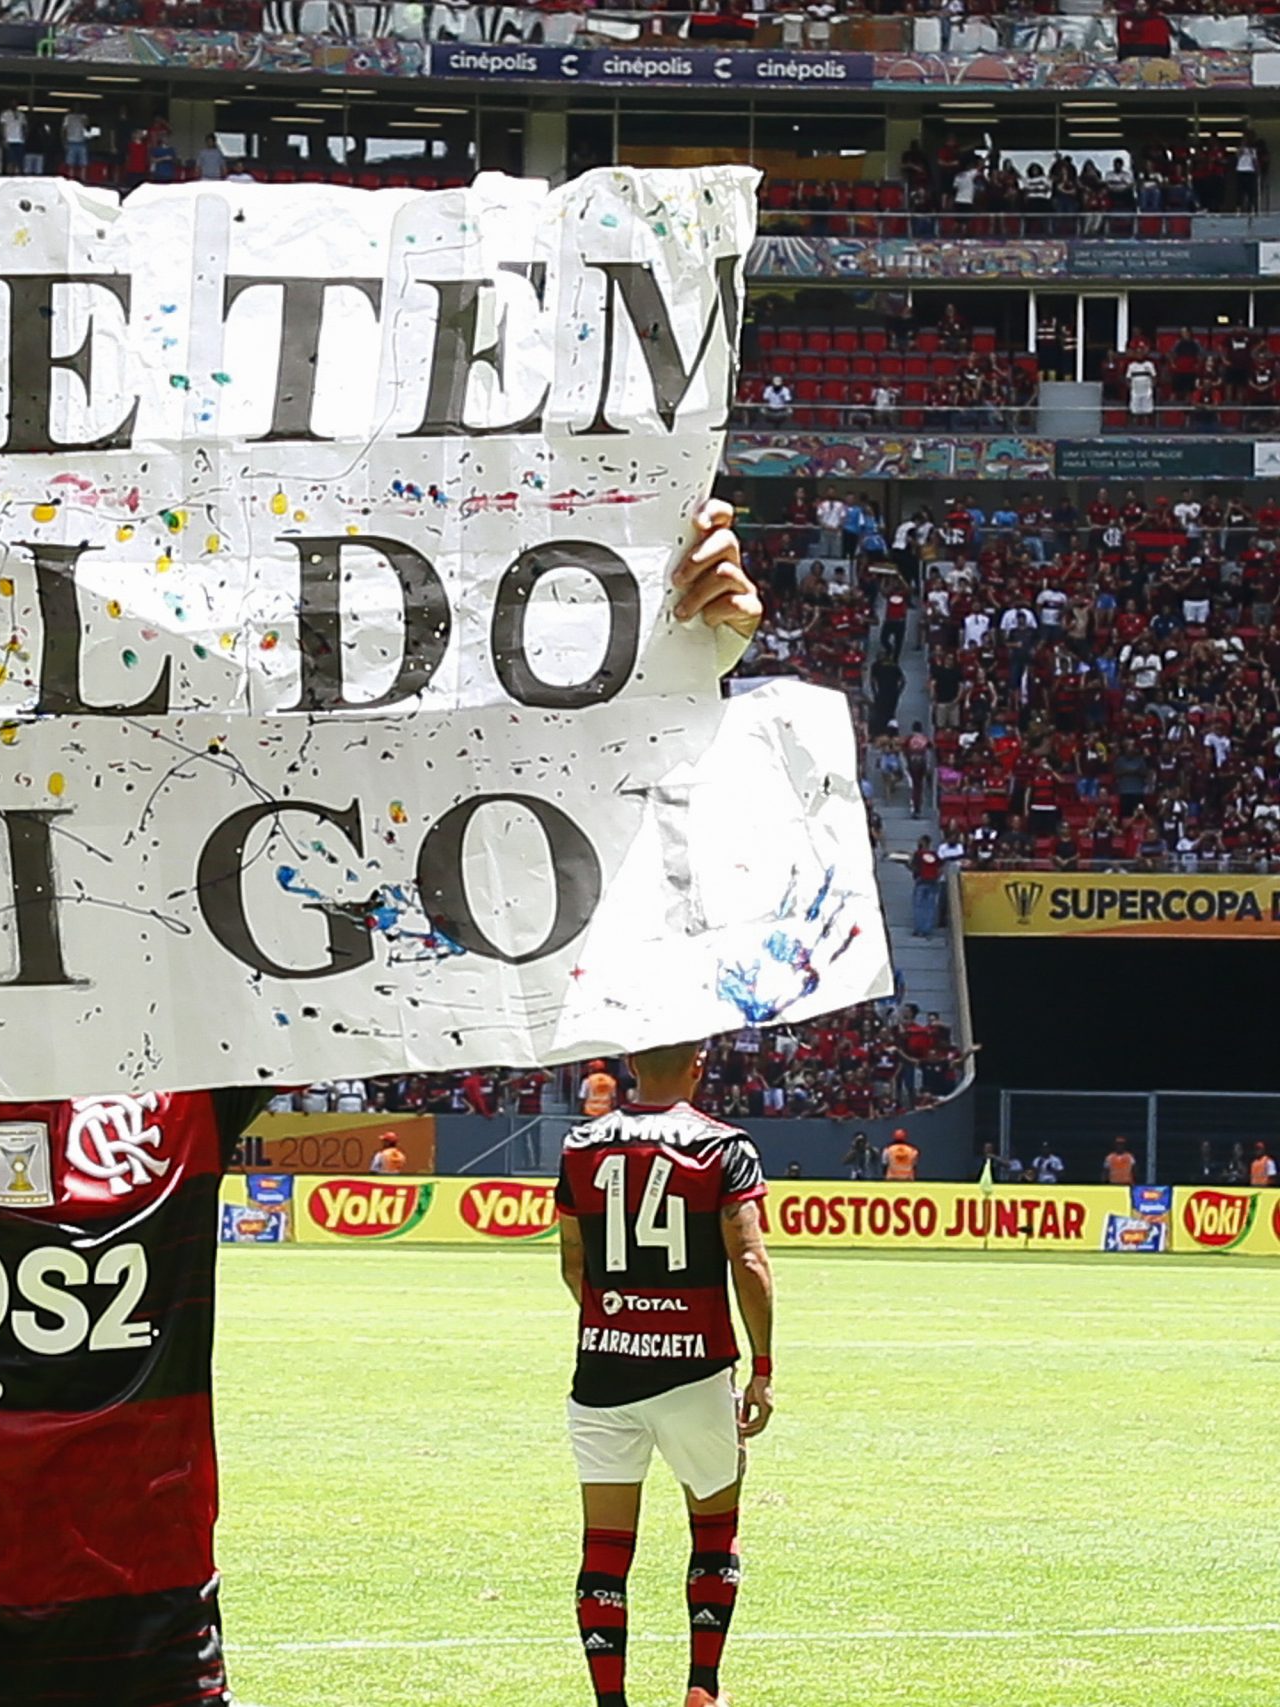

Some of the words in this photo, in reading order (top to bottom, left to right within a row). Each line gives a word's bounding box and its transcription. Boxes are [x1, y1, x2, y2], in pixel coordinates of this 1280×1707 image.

[448, 52, 538, 73] cinépolis
[603, 55, 693, 78] cinépolis
[756, 59, 847, 81] cinépolis
[222, 254, 742, 442] TEM
[275, 535, 641, 713] DO
[1048, 887, 1262, 922] SUPERCOPA
[278, 1135, 364, 1169] 2020
[317, 1186, 408, 1228] Yoki
[469, 1188, 556, 1229] Yoki
[593, 1154, 687, 1273] 14
[779, 1195, 938, 1237] GOSTOSO
[944, 1197, 1087, 1240] JUNTAR
[1189, 1197, 1244, 1238] Yoki
[623, 1294, 689, 1312] TOTAL
[581, 1327, 596, 1352] DE
[598, 1328, 706, 1359] ARRASCAETA
